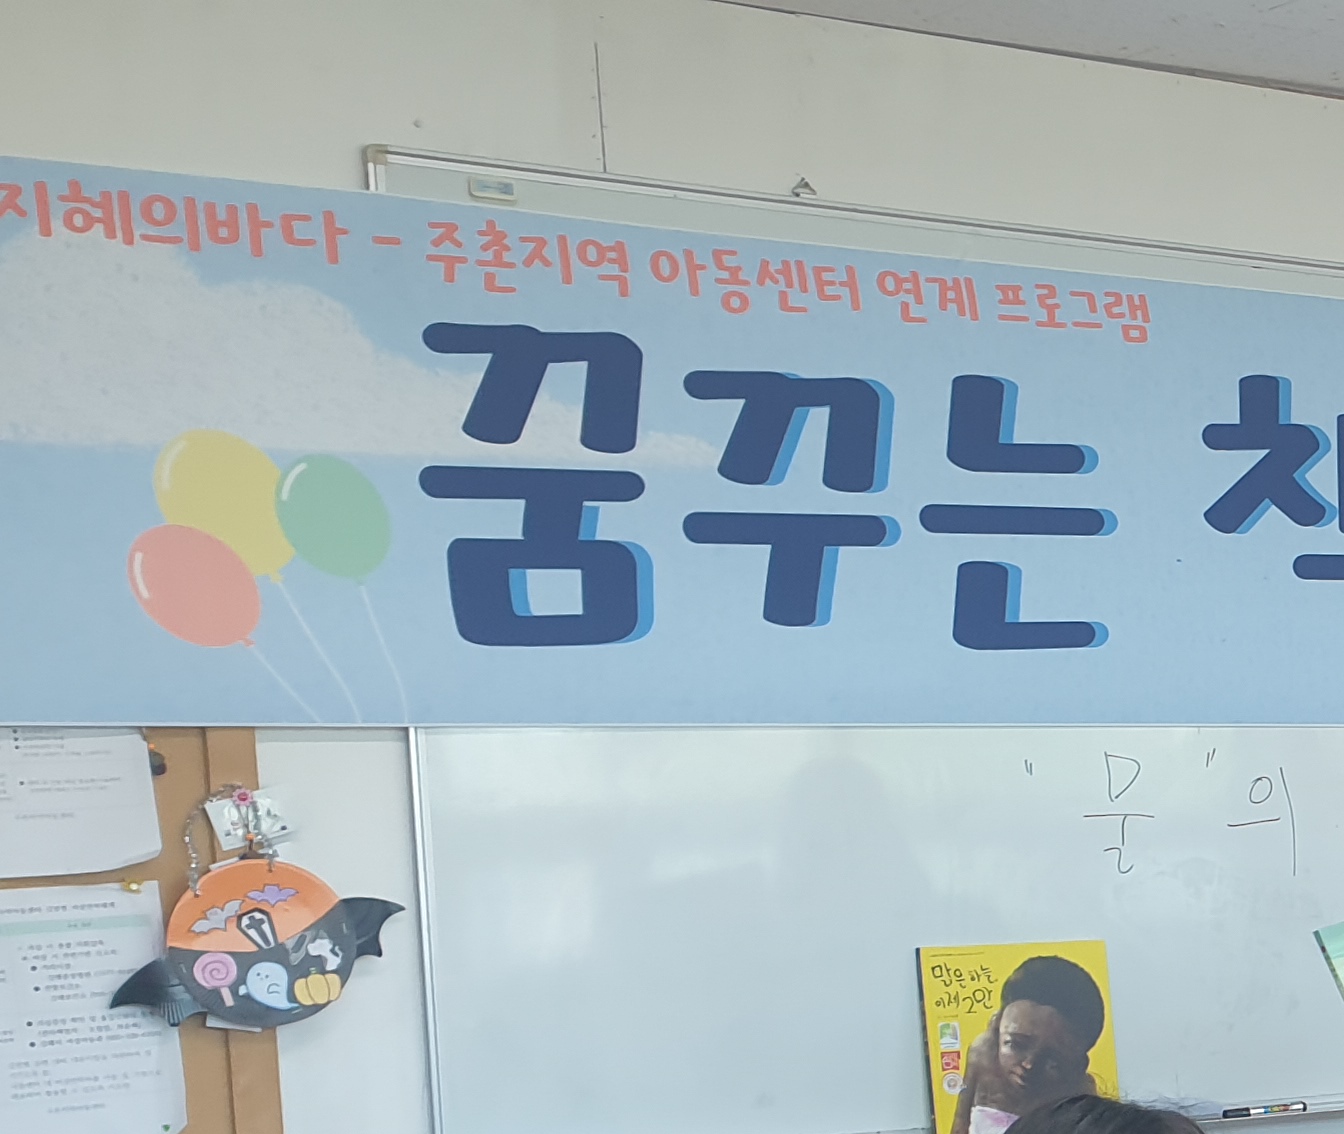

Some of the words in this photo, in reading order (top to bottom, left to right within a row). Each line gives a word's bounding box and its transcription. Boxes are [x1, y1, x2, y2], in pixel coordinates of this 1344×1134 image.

[0, 179, 349, 265] 지혜의바다
[425, 219, 630, 298] 주촌지역
[650, 249, 862, 315] 아동센터
[876, 270, 980, 323] 연계
[994, 282, 1152, 344] 프로그램
[417, 321, 1119, 652] 꿈꾸는
